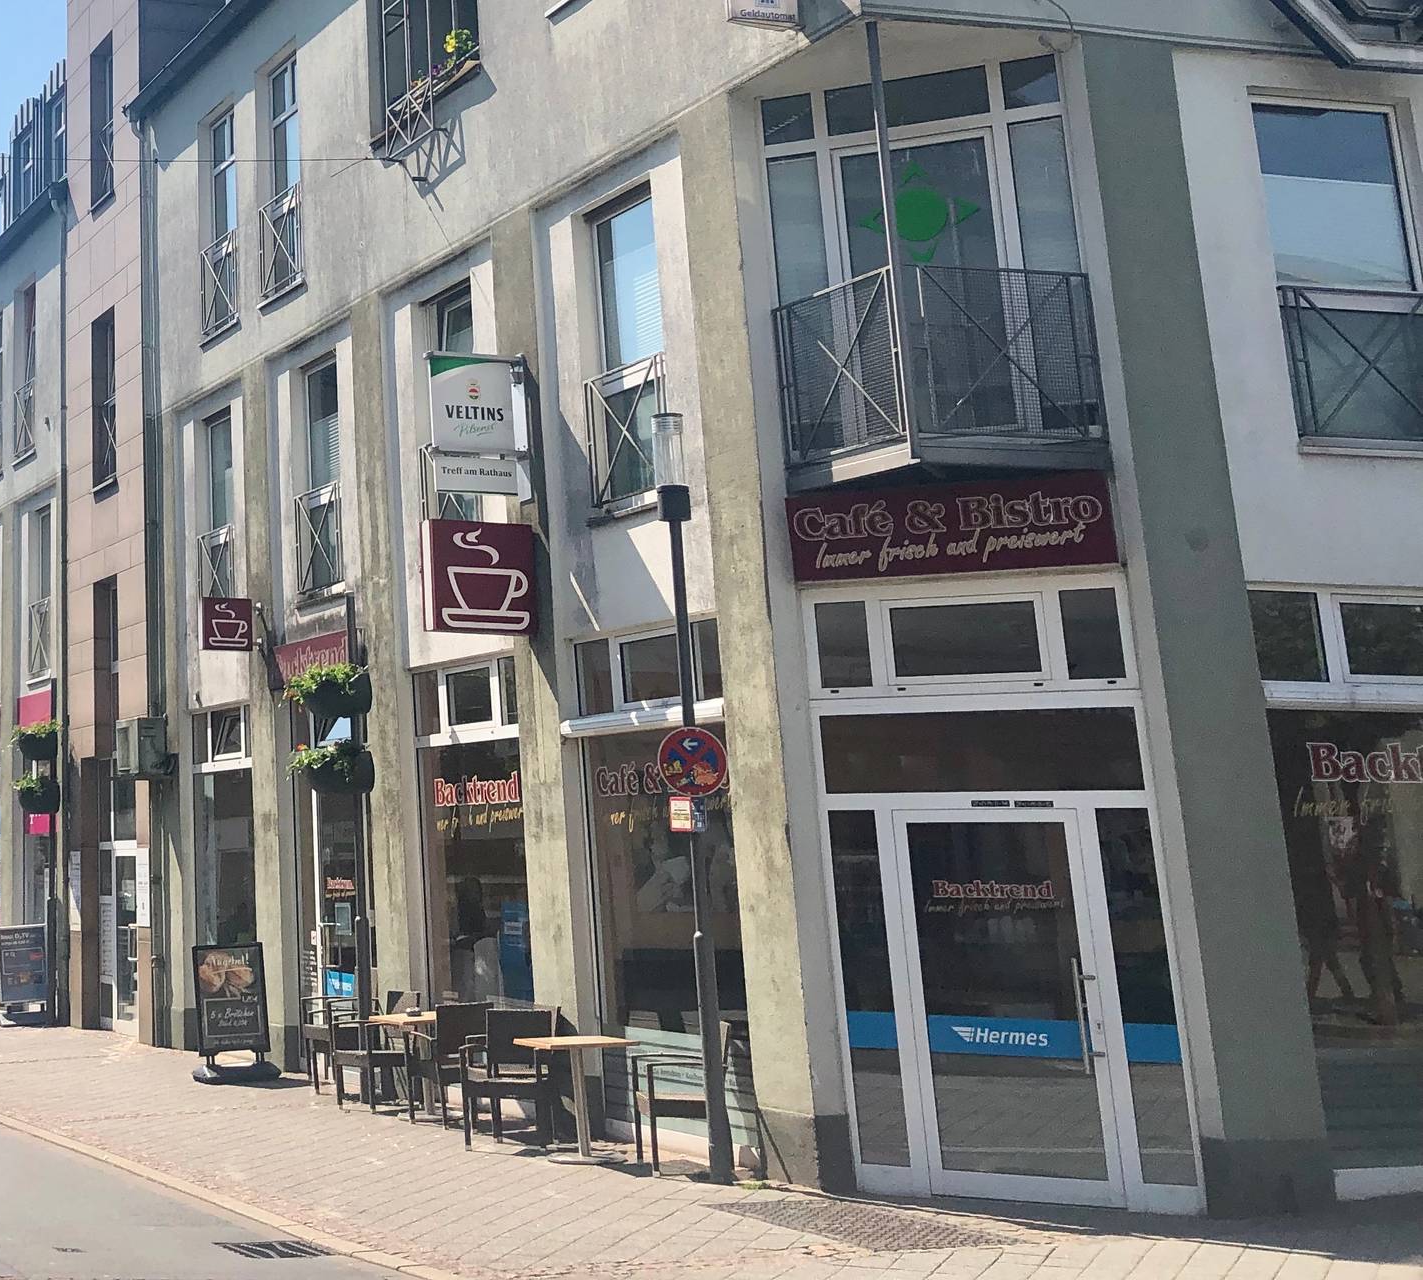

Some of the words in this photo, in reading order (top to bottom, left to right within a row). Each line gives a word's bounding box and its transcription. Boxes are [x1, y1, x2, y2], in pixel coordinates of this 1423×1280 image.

[740, 9, 796, 20] Geldautomat
[445, 404, 504, 421] VELTINS
[441, 466, 463, 475] Treff
[479, 467, 512, 477] Rathaus
[793, 500, 894, 541] Café
[905, 500, 947, 534] &
[956, 490, 1103, 531] Bistro
[816, 543, 872, 569] Immer
[877, 533, 939, 572] frisch
[946, 529, 980, 557] und
[982, 522, 1087, 563] preiswert
[595, 760, 640, 796] Café
[643, 762, 663, 794] &
[434, 770, 521, 807] Backtrend
[932, 880, 1055, 899] Backtrend
[975, 1027, 1049, 1046] Hermes
